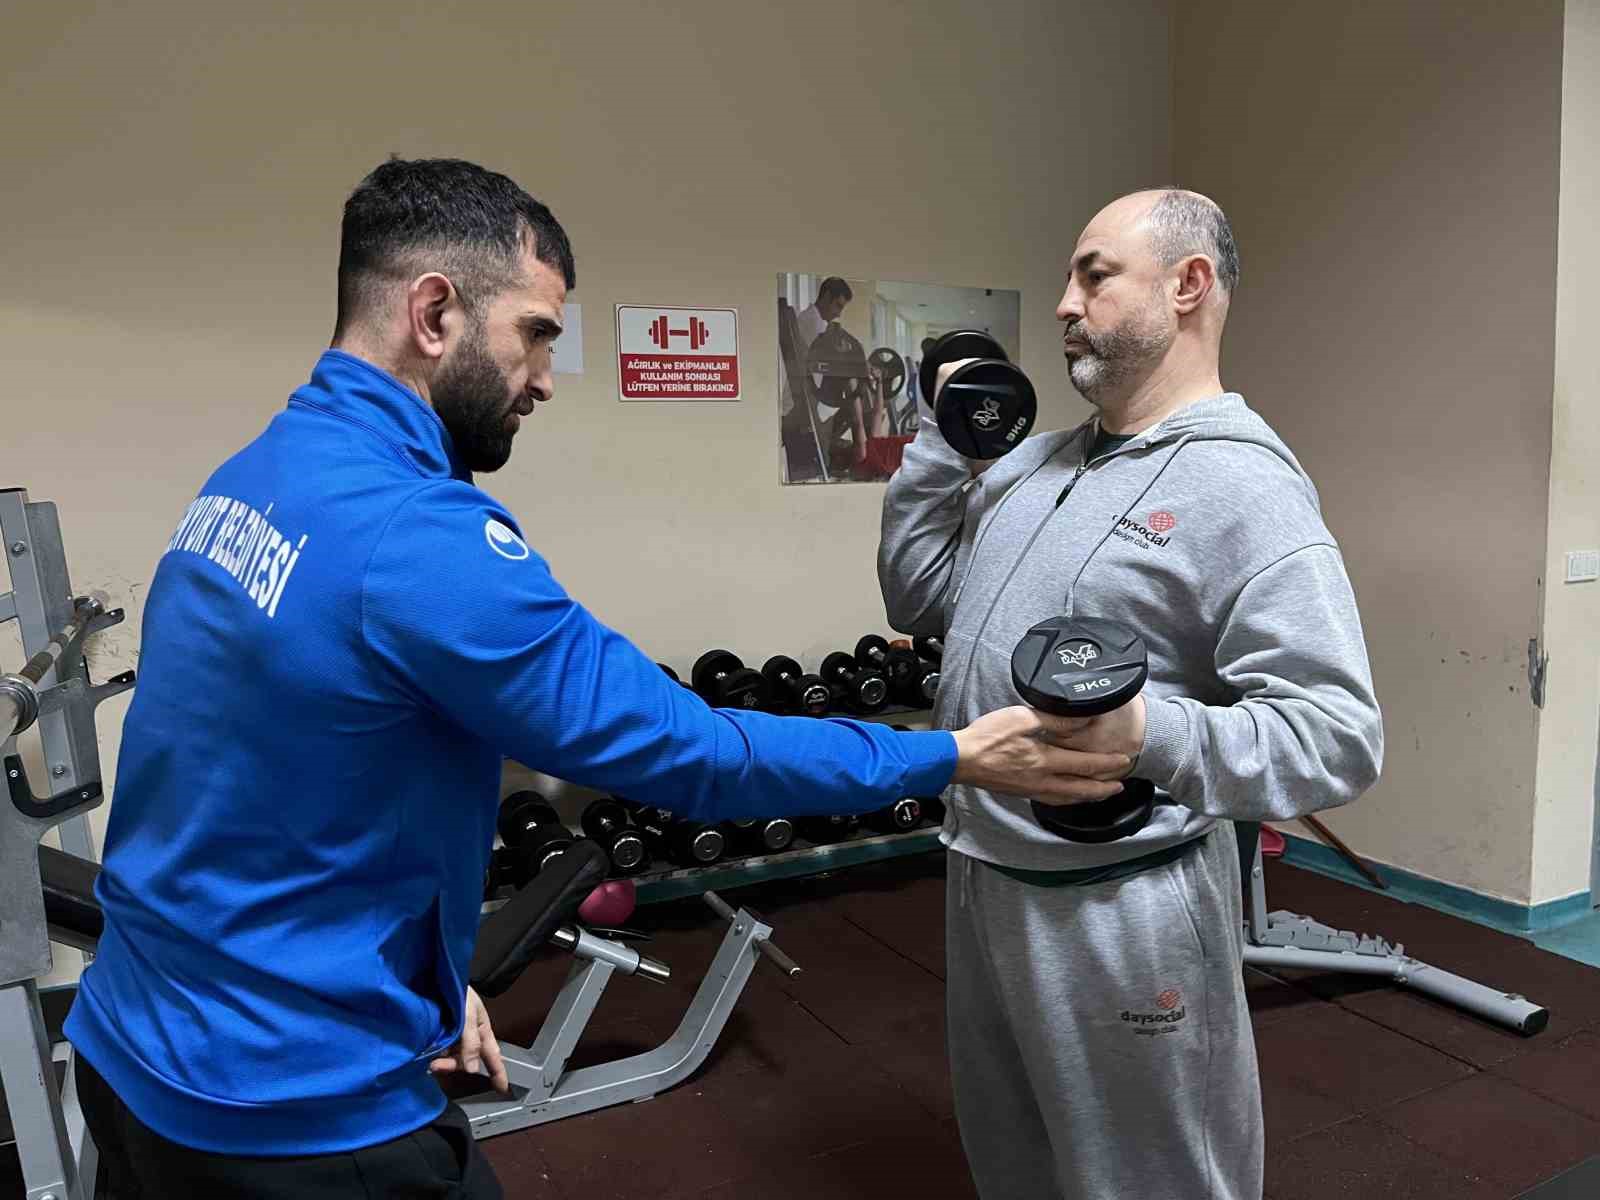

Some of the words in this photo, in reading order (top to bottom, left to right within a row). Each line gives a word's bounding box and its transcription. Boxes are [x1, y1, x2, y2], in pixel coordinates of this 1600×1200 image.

[627, 359, 661, 369] AĞIRLIK
[662, 362, 673, 370] ve
[674, 360, 730, 370] EKİPMANLARI
[640, 372, 684, 381] KULLANIM
[685, 372, 721, 381] SONRASI
[627, 380, 660, 392] LÜTFEN
[661, 381, 692, 392] YERİNE
[693, 383, 735, 392] BIRAKINIZ
[1005, 416, 1028, 442] 3KG
[207, 498, 309, 619] BELEDİYESİ
[1072, 678, 1112, 693] 3KG
